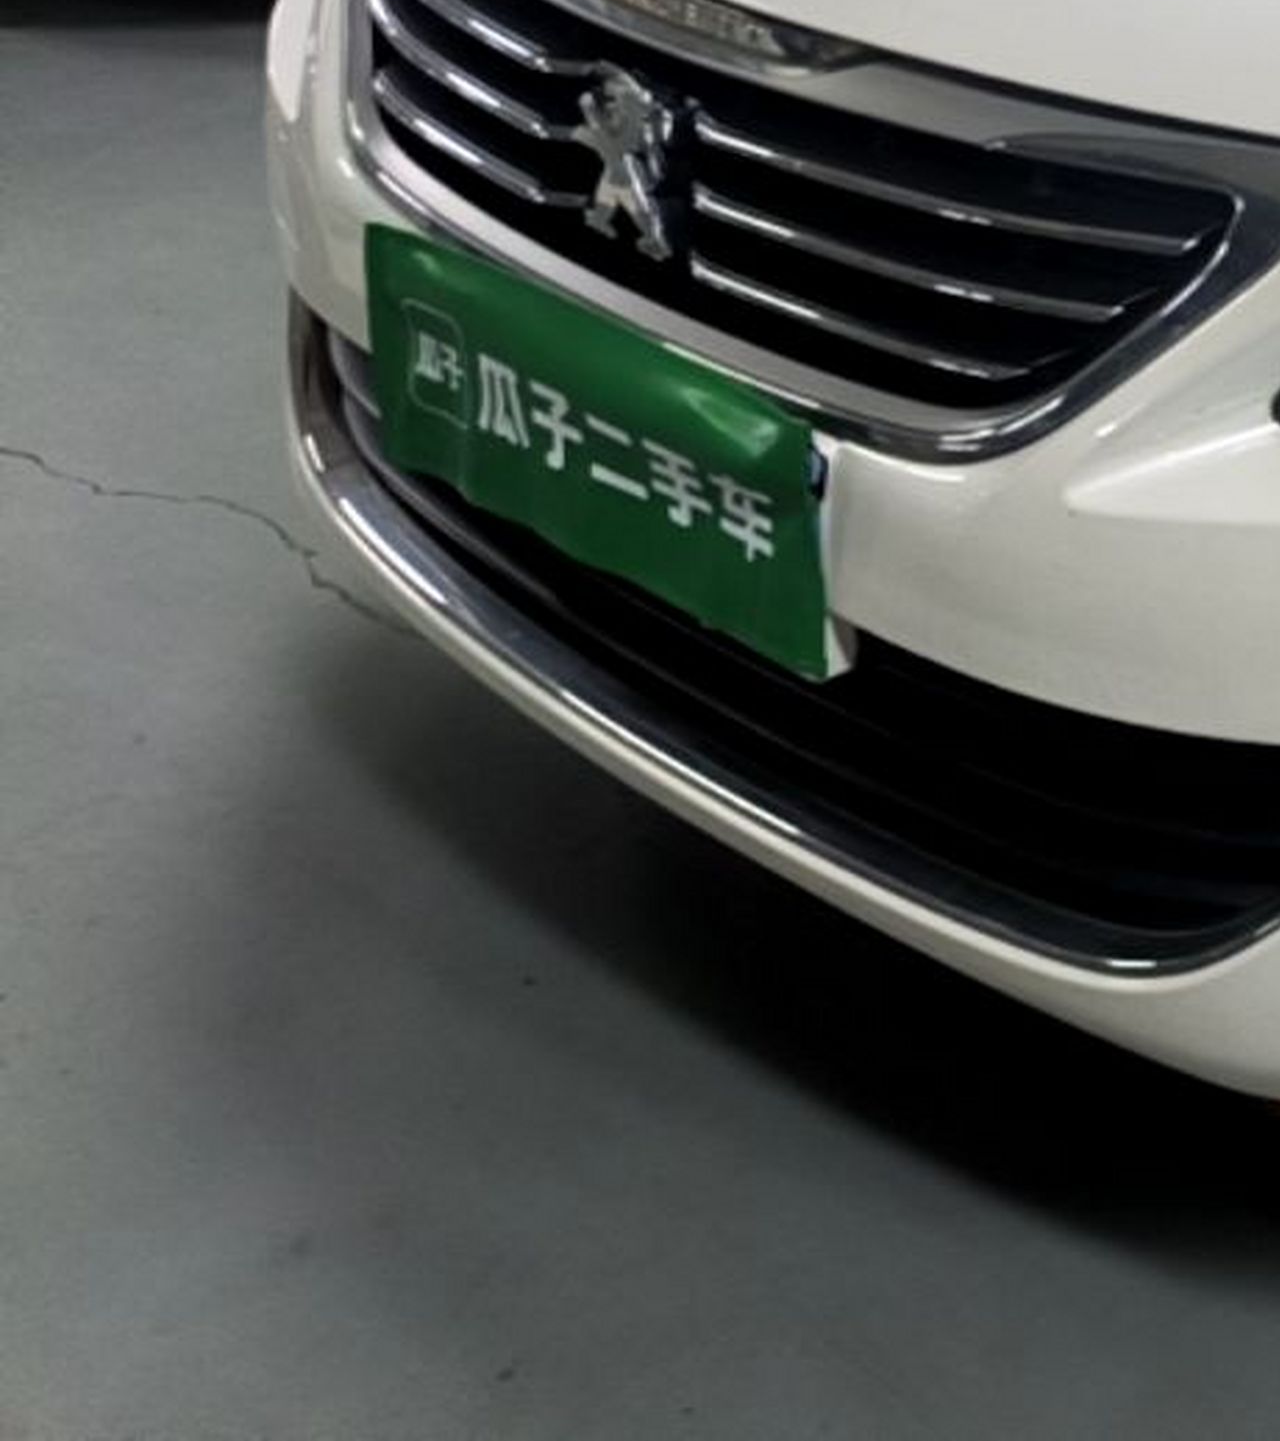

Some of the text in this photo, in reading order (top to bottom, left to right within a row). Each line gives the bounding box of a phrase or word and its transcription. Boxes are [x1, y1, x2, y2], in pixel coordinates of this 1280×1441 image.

[478, 353, 774, 561] 瓜子二手车
